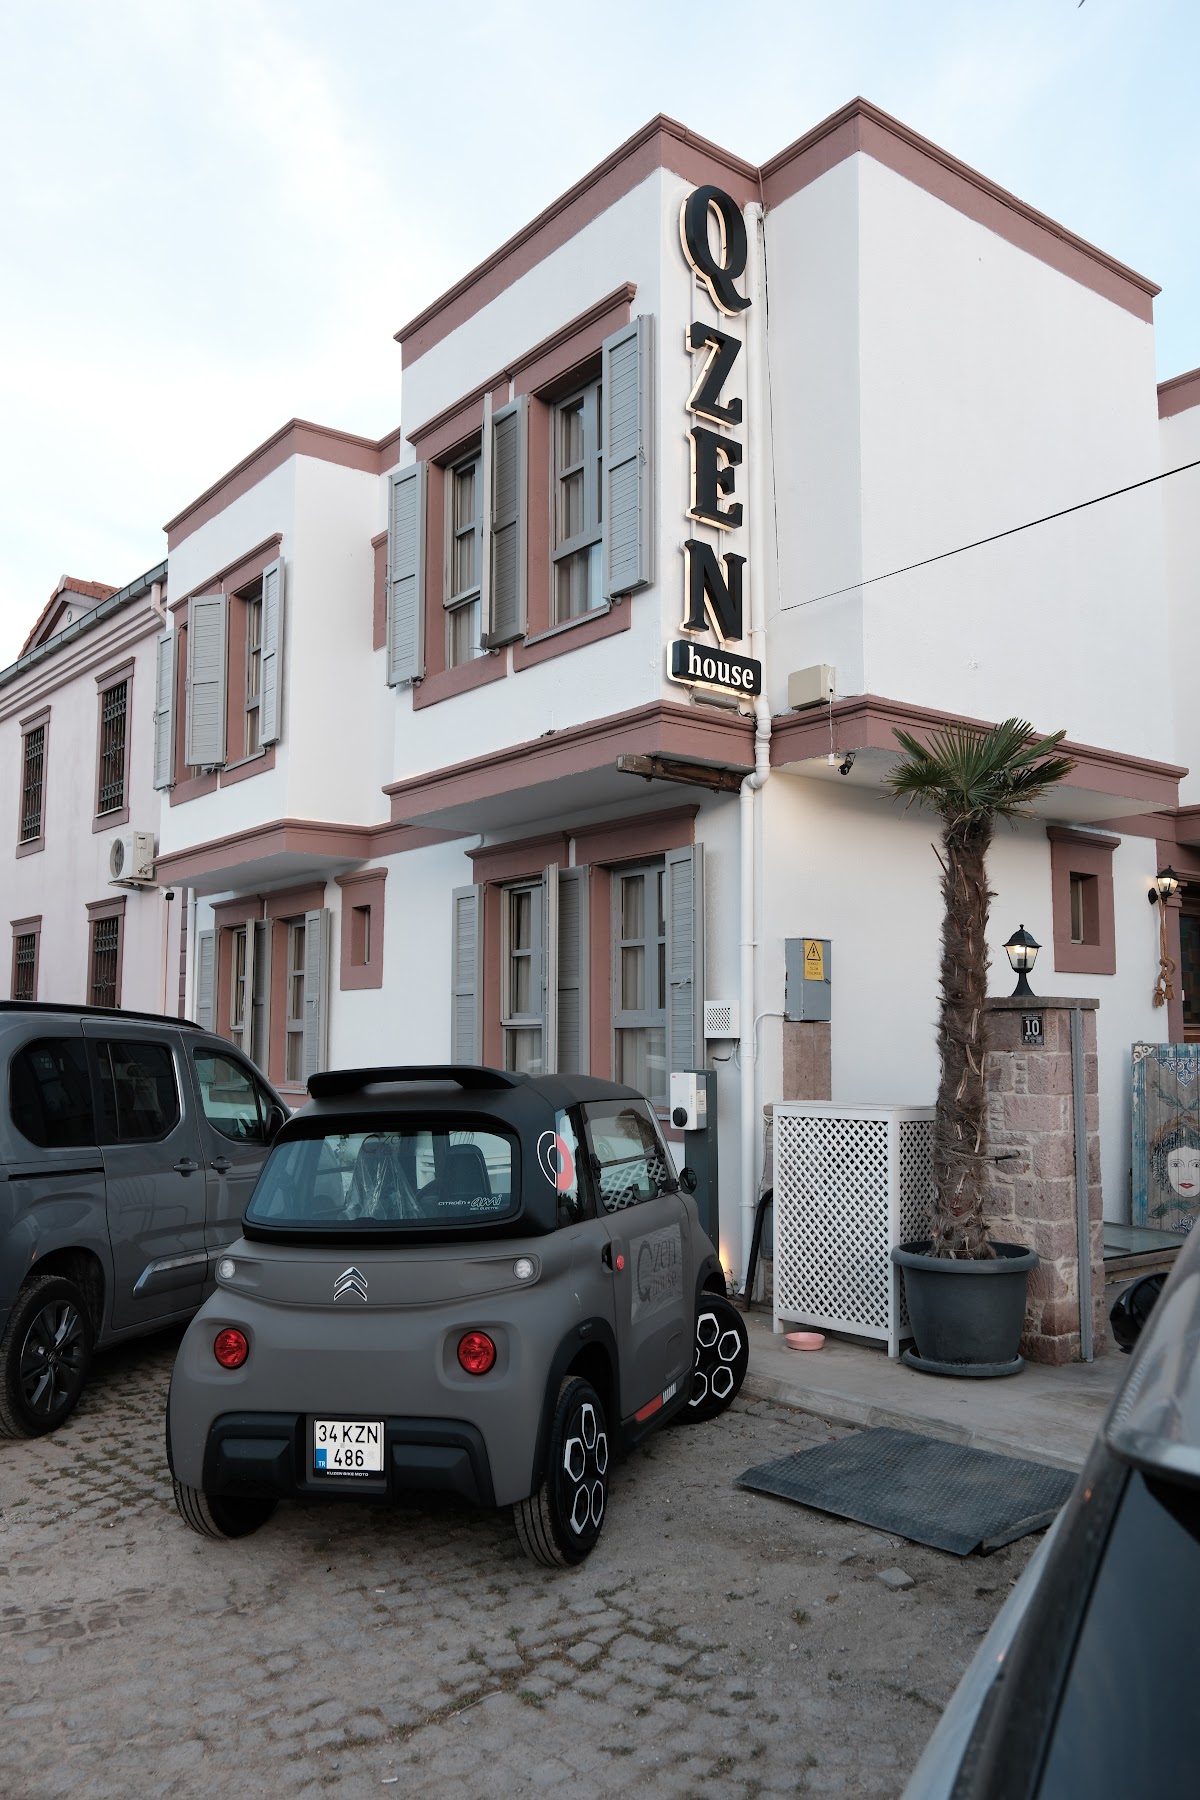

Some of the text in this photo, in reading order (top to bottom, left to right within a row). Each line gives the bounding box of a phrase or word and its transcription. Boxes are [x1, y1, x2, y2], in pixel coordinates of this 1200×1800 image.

[681, 184, 752, 642] QZEN
[687, 644, 754, 689] house
[1025, 1020, 1040, 1035] 10
[470, 1194, 503, 1208] ami
[318, 1424, 378, 1444] 34 KZN
[318, 1448, 364, 1468] TR 486
